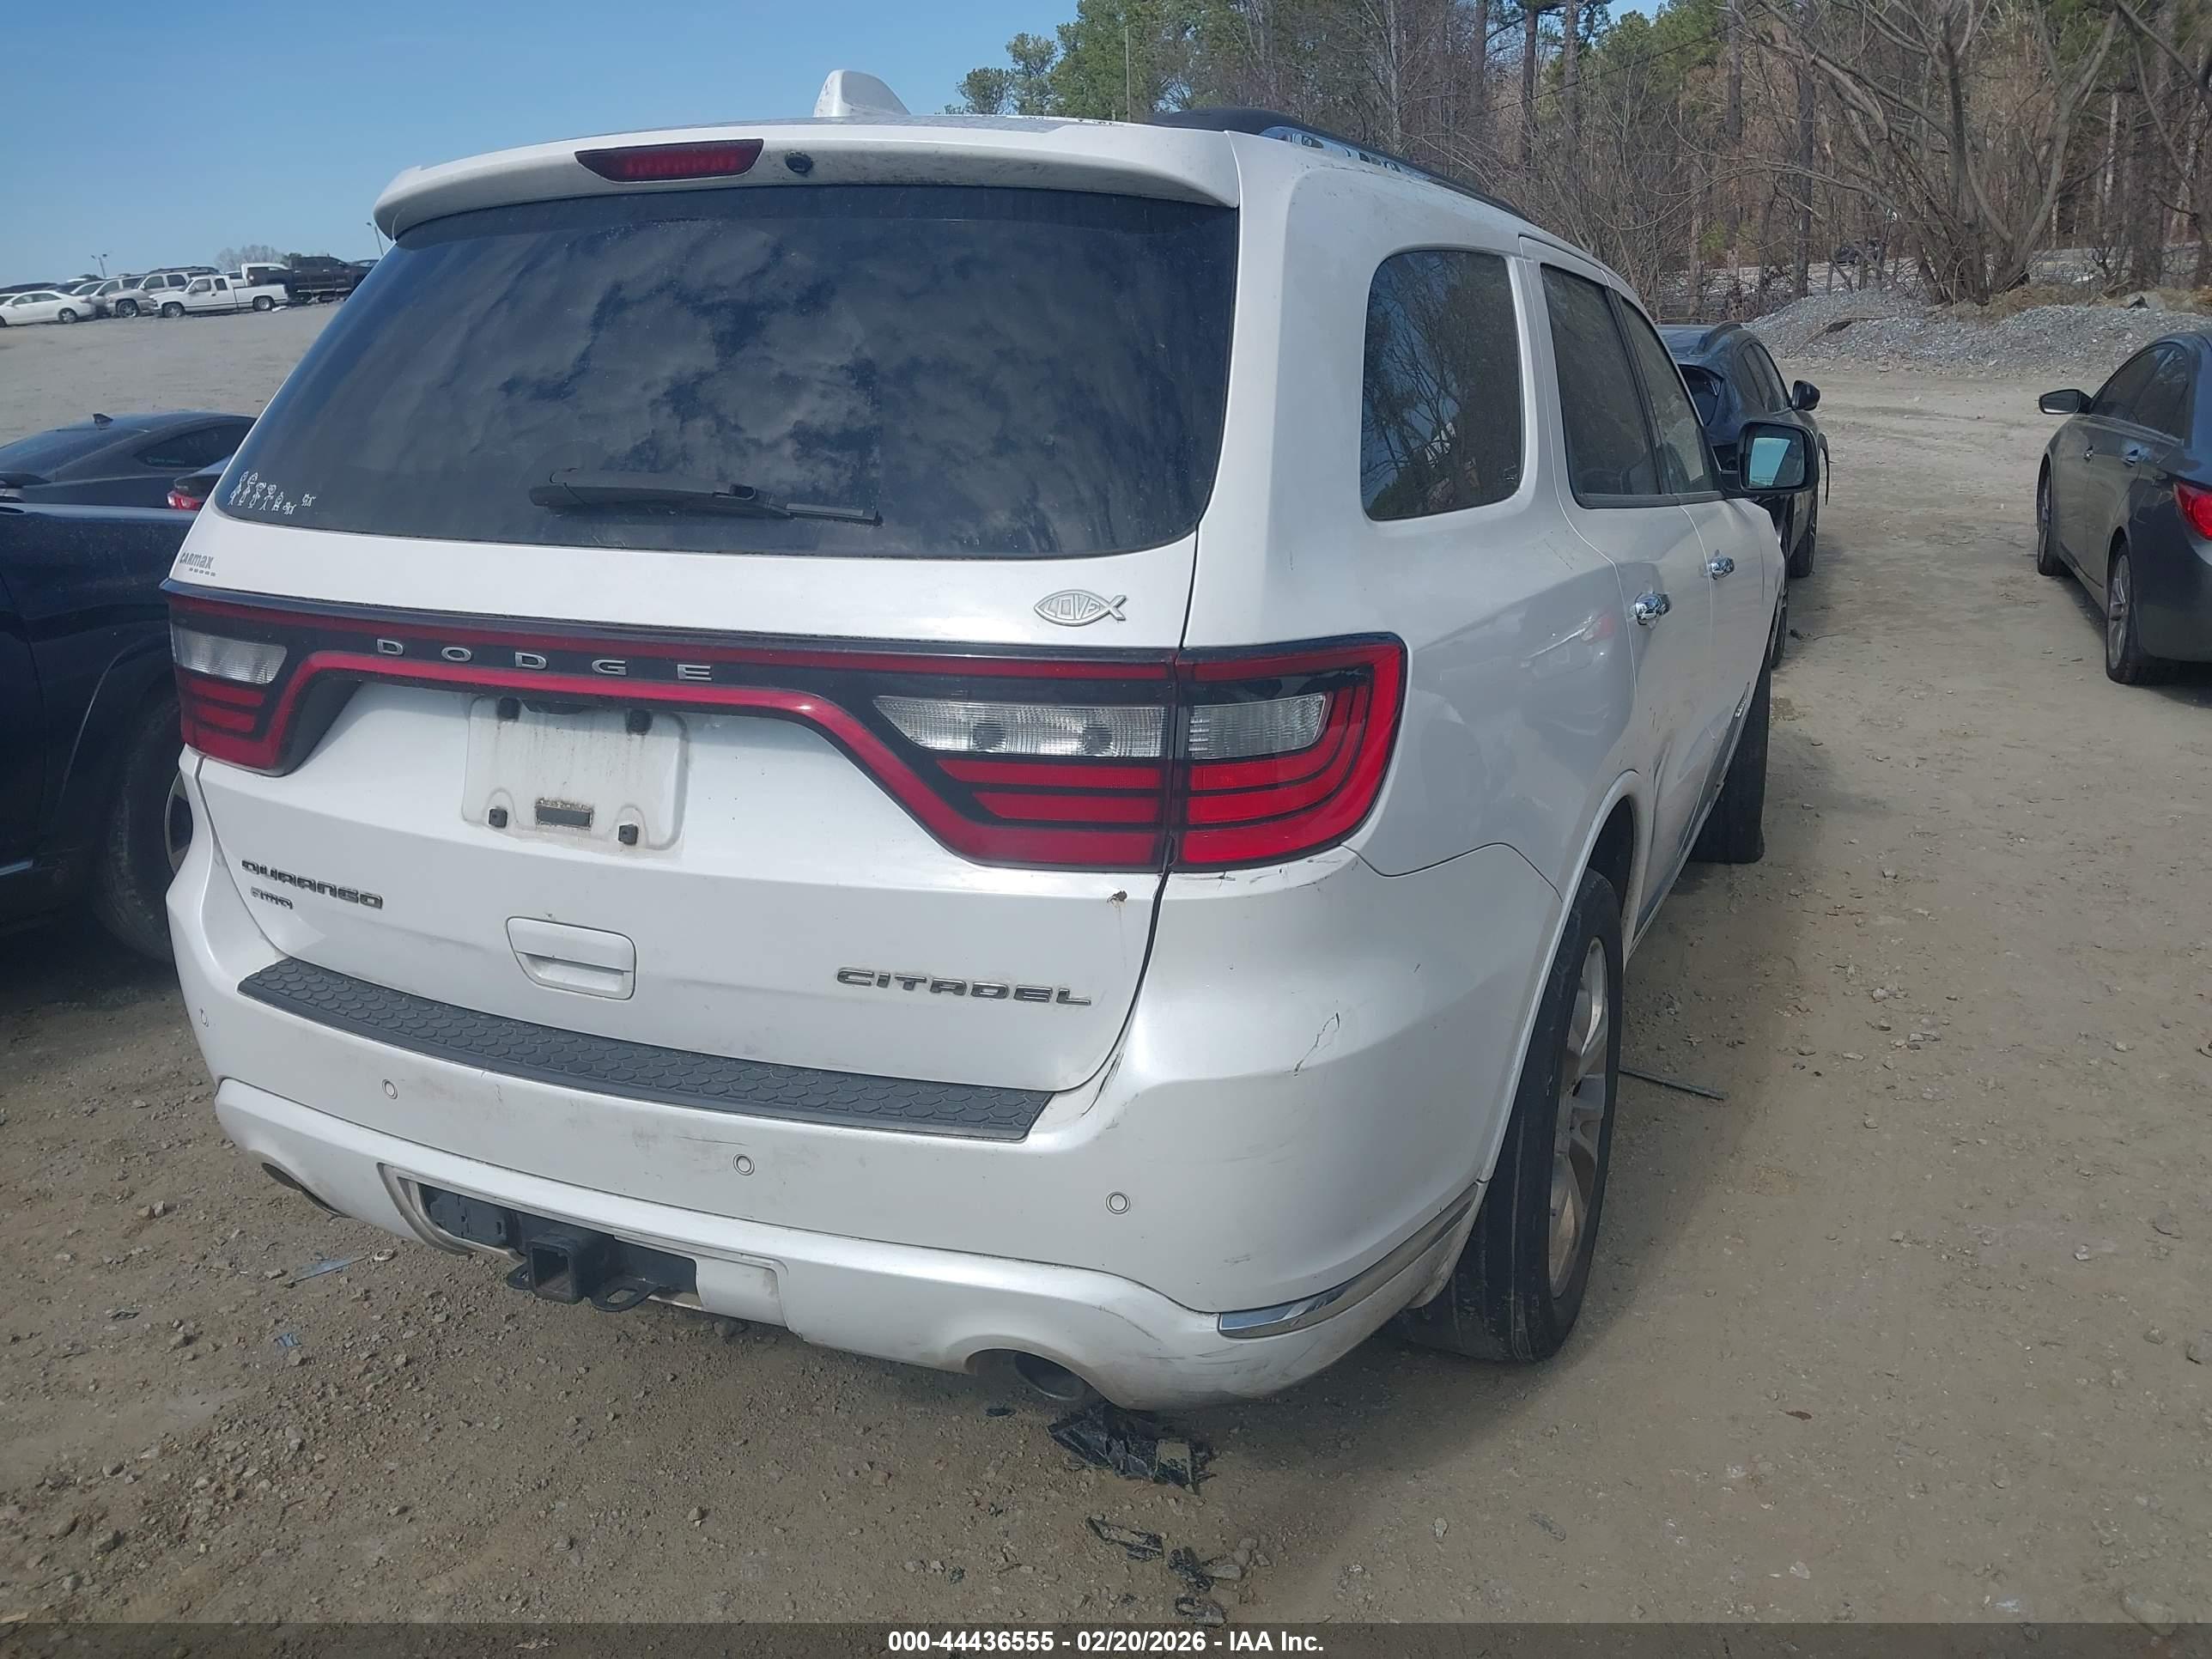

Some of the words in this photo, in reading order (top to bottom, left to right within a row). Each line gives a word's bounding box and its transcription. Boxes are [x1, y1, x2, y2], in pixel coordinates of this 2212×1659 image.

[376, 638, 713, 681] DODGE
[241, 860, 384, 909] DURANGO
[836, 968, 1091, 1006] CITADEL
